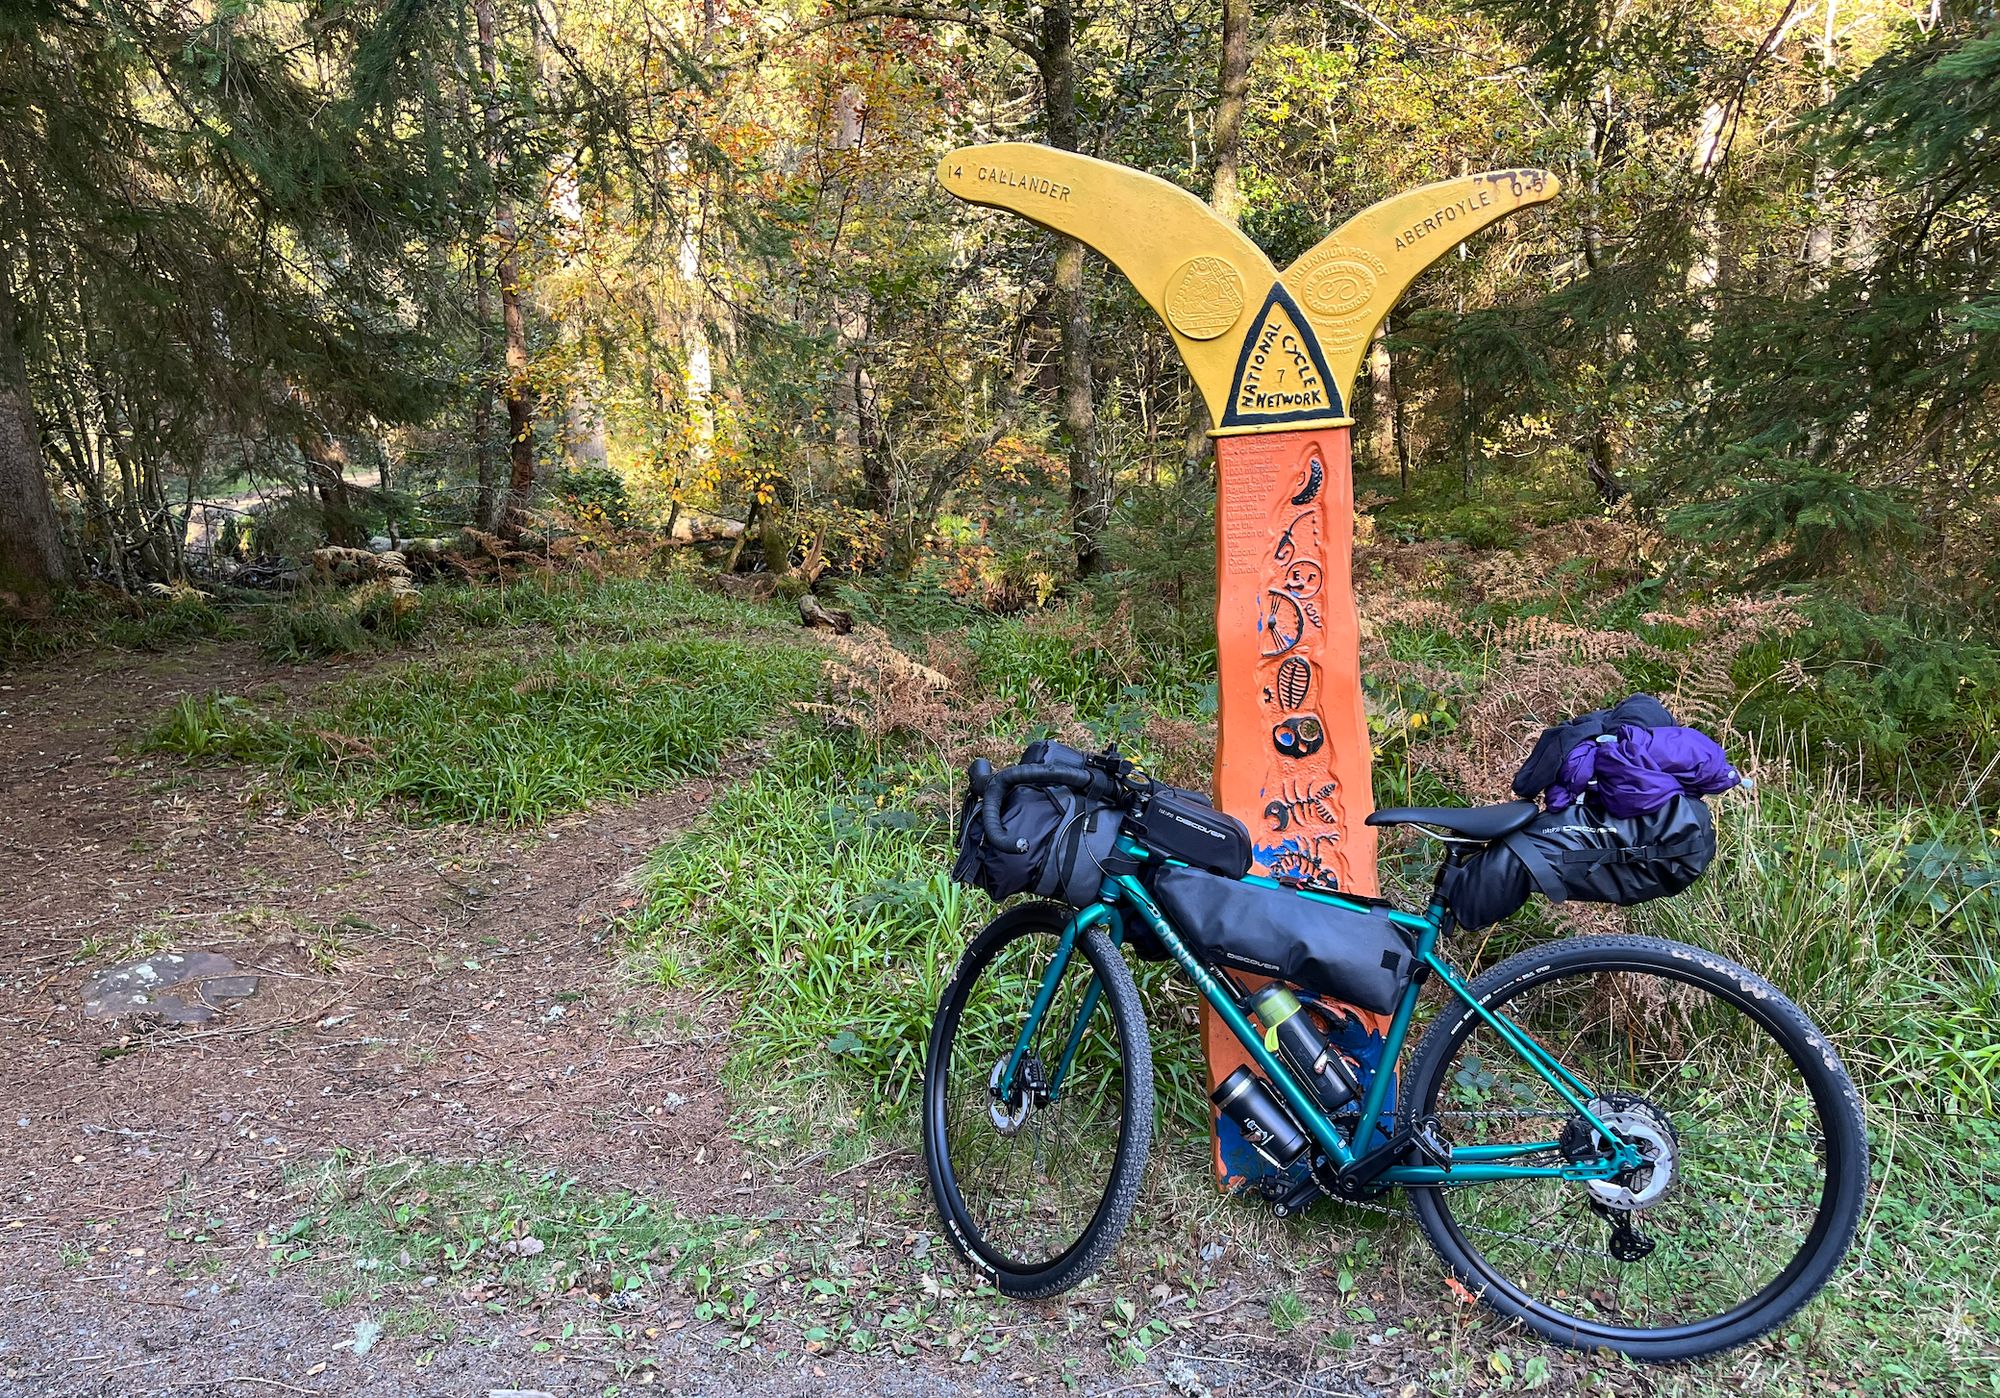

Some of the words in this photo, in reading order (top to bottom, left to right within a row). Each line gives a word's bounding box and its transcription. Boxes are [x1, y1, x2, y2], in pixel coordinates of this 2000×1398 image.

[947, 164, 963, 180] 14
[977, 166, 1073, 203] CALLANDER
[1393, 190, 1492, 252] ABERFOYLE
[1289, 245, 1348, 289] MILLENNIUM
[1349, 246, 1389, 277] PROJECT
[1241, 323, 1282, 408] NATIONAL
[1276, 369, 1285, 383] 7
[1282, 334, 1317, 388] CYCLE
[1256, 389, 1322, 408] NETWORK
[1292, 570, 1300, 581] E
[1307, 573, 1316, 583] F
[1175, 815, 1227, 840] DISCOVER
[1154, 919, 1217, 994] GENESIS
[1226, 952, 1280, 971] DISCOVER
